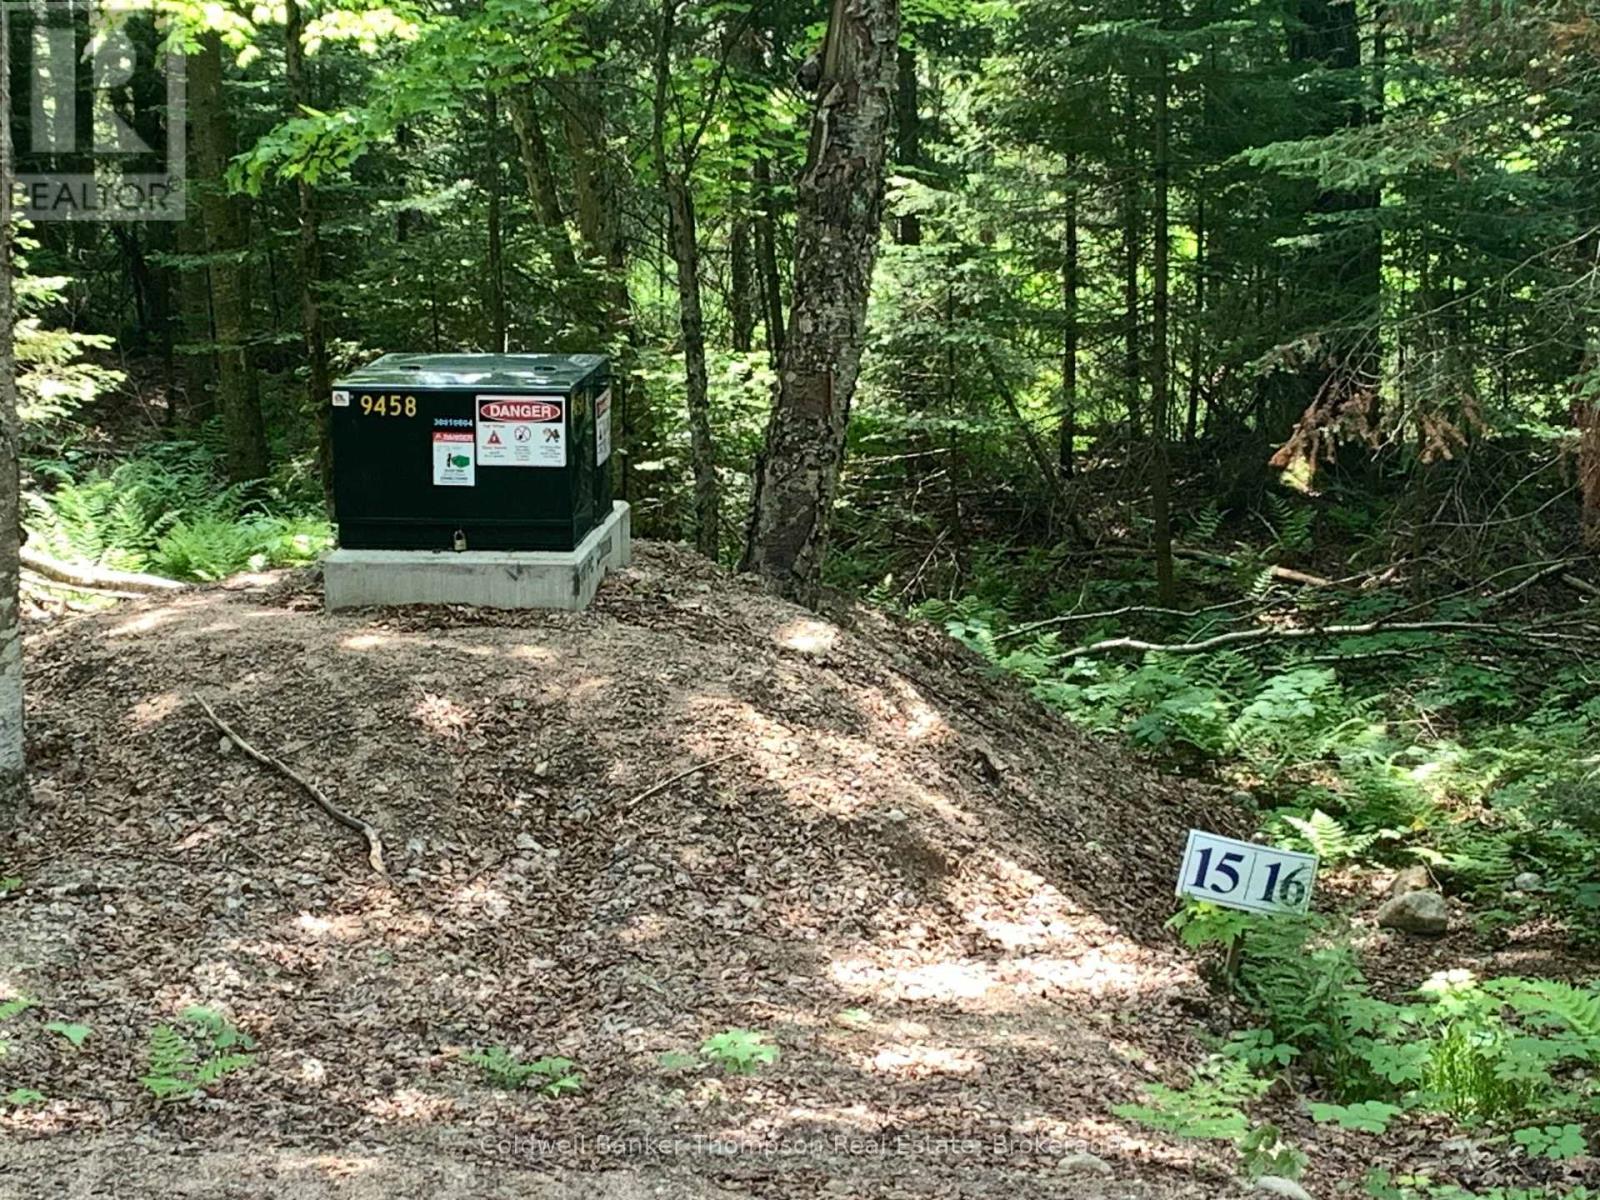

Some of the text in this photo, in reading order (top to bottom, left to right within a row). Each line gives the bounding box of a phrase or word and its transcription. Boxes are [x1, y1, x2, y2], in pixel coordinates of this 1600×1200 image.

[360, 394, 417, 418] 9458
[489, 404, 551, 418] DANGER
[1187, 847, 1310, 907] 15 16
